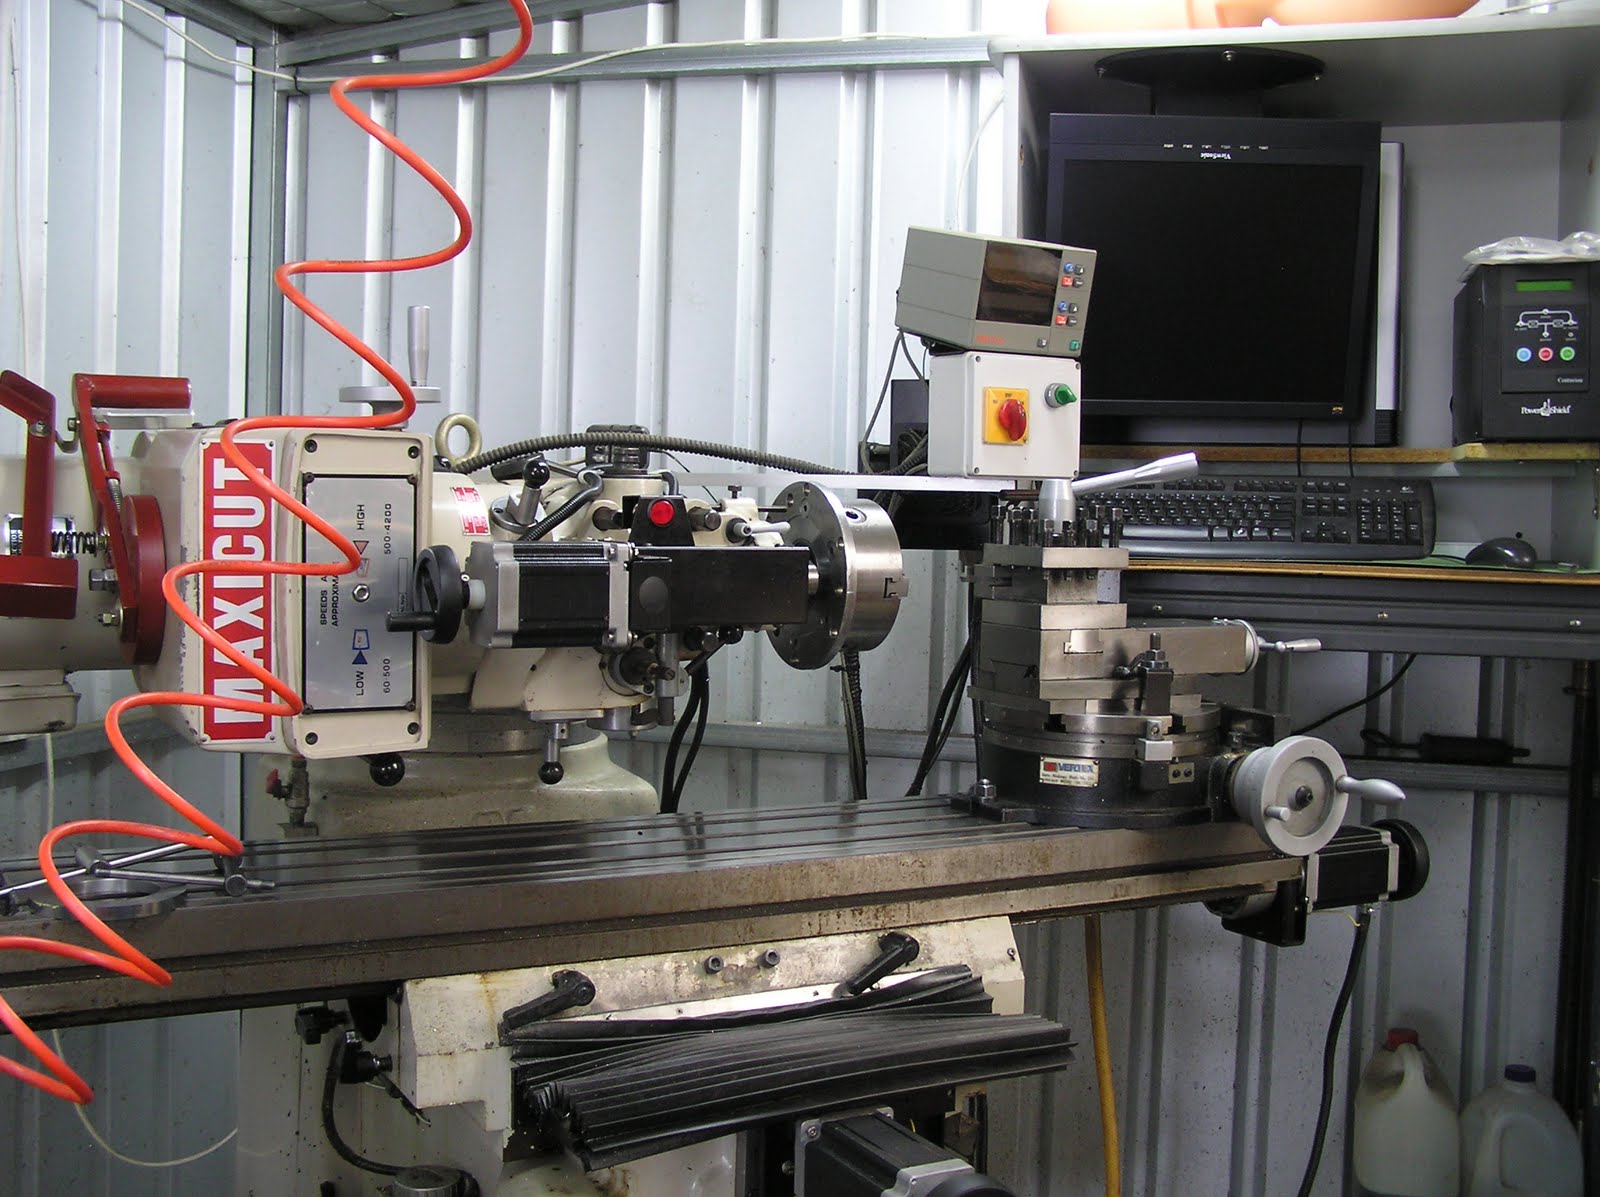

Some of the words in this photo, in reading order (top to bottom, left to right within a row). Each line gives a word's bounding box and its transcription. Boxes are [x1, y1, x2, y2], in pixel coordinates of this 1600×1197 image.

[1200, 152, 1231, 160] ViewSonic
[356, 503, 366, 531] HIGH
[212, 458, 266, 723] MAXICUT
[319, 589, 328, 626] SPEEDS
[355, 670, 365, 696] LOW
[1058, 763, 1094, 773] VERTEX
